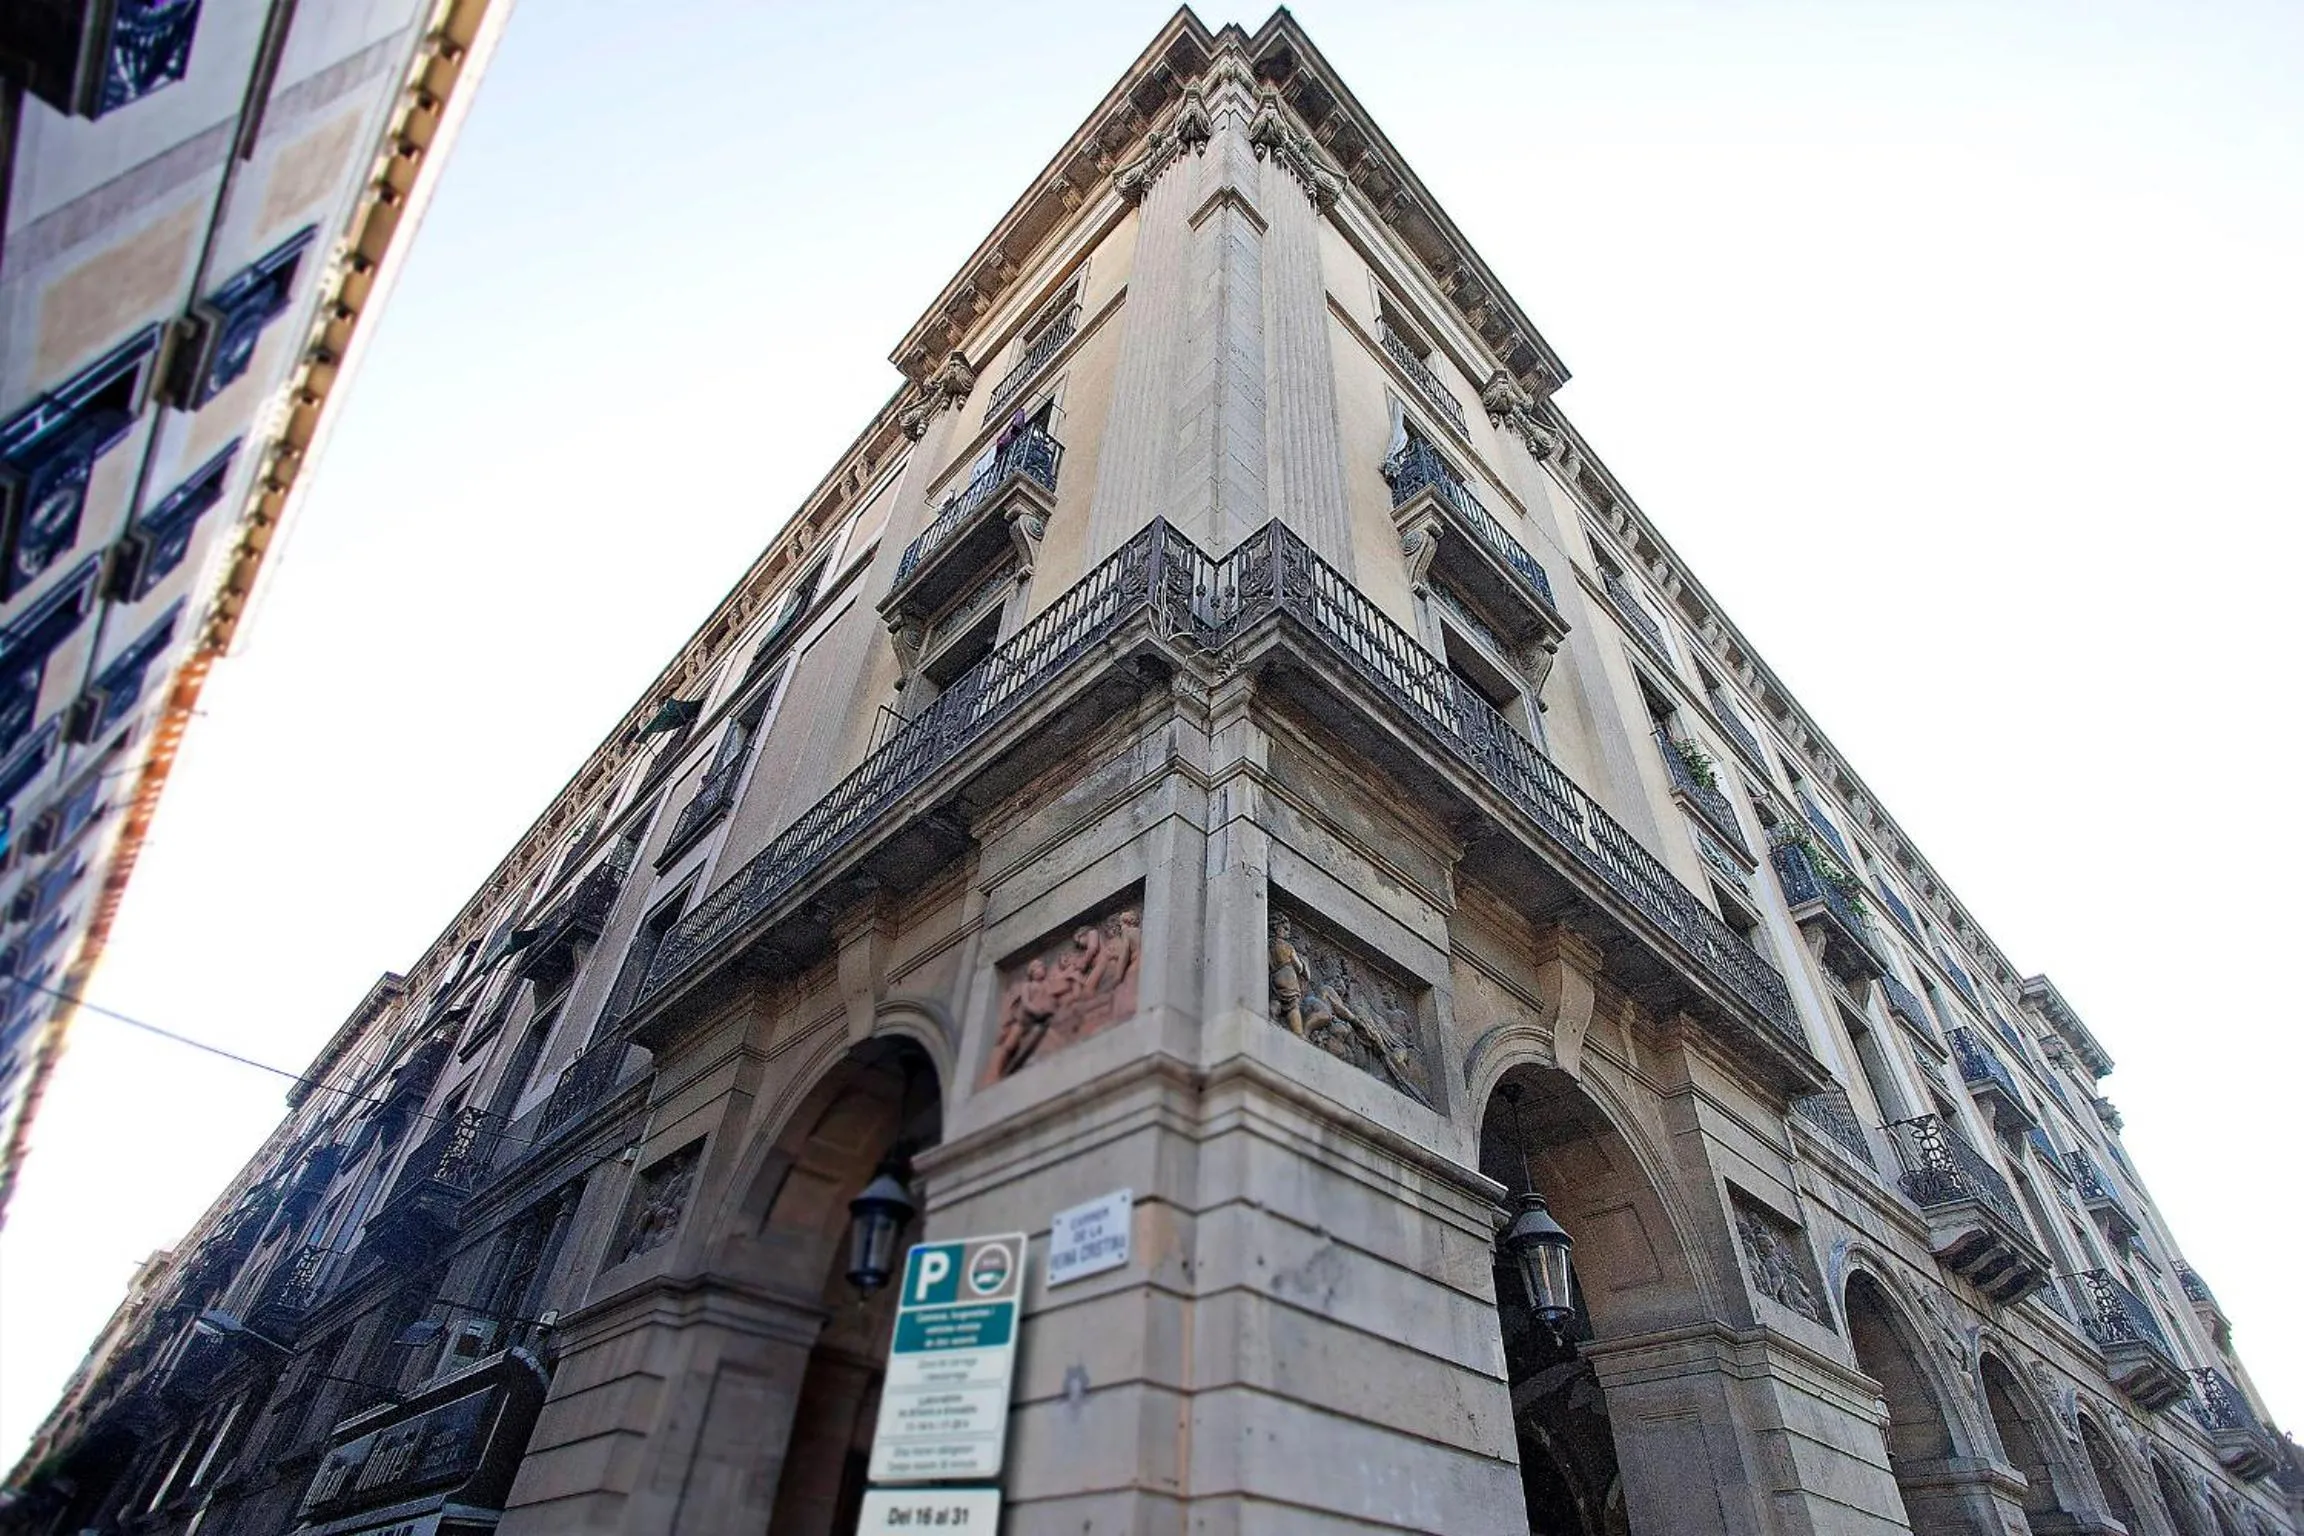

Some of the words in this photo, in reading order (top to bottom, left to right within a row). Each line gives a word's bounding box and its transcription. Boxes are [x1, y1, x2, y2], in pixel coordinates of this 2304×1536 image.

[915, 1251, 950, 1301] P
[887, 1506, 912, 1526] Del
[915, 1506, 932, 1526] 16
[934, 1506, 950, 1526] al
[951, 1506, 969, 1526] 31
